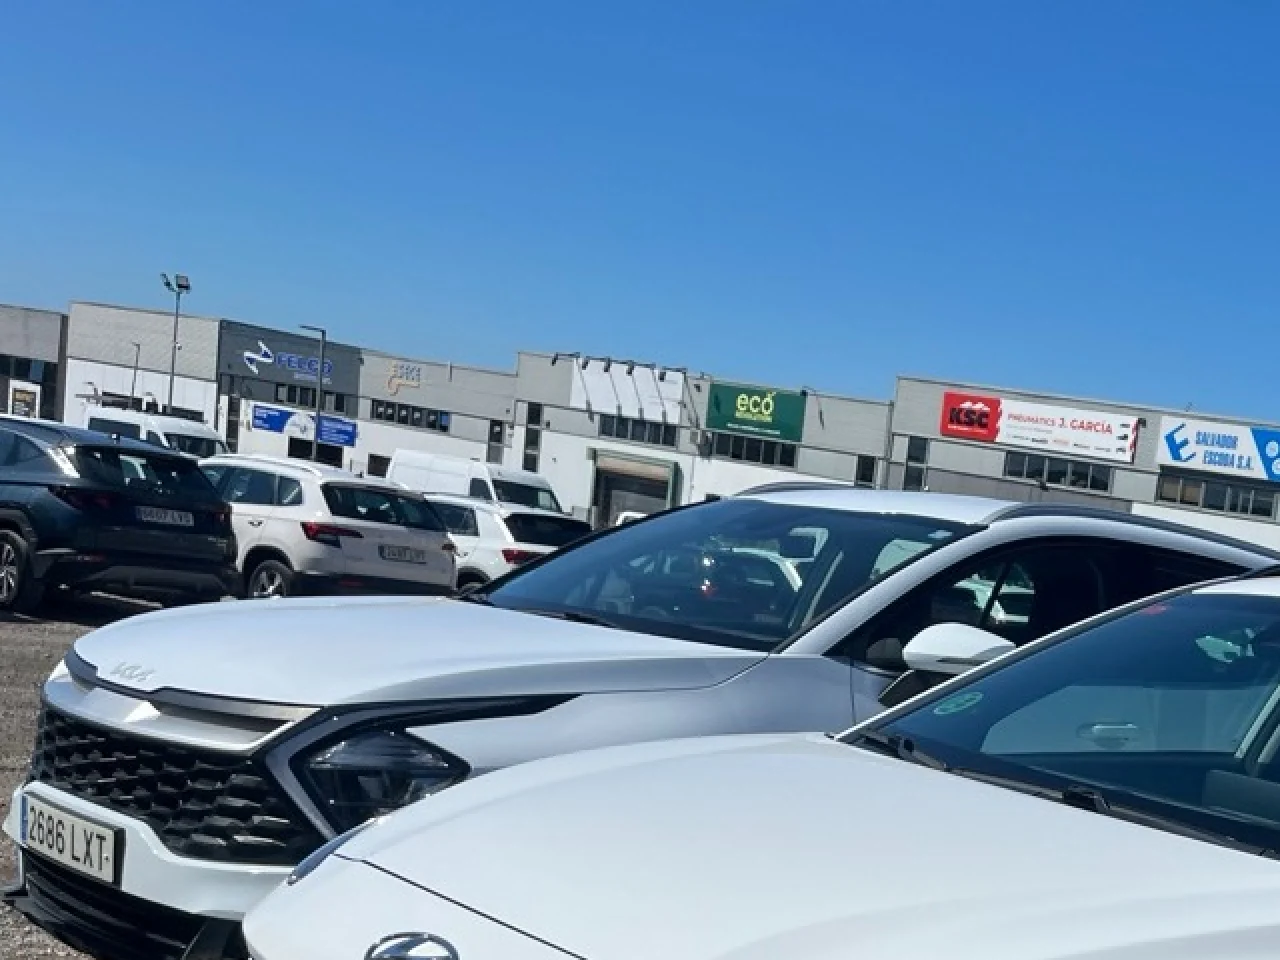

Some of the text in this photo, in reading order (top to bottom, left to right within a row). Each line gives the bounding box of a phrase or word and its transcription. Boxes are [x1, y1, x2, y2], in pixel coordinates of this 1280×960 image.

[949, 407, 991, 429] KSC
[29, 805, 107, 872] 2686 LXT
